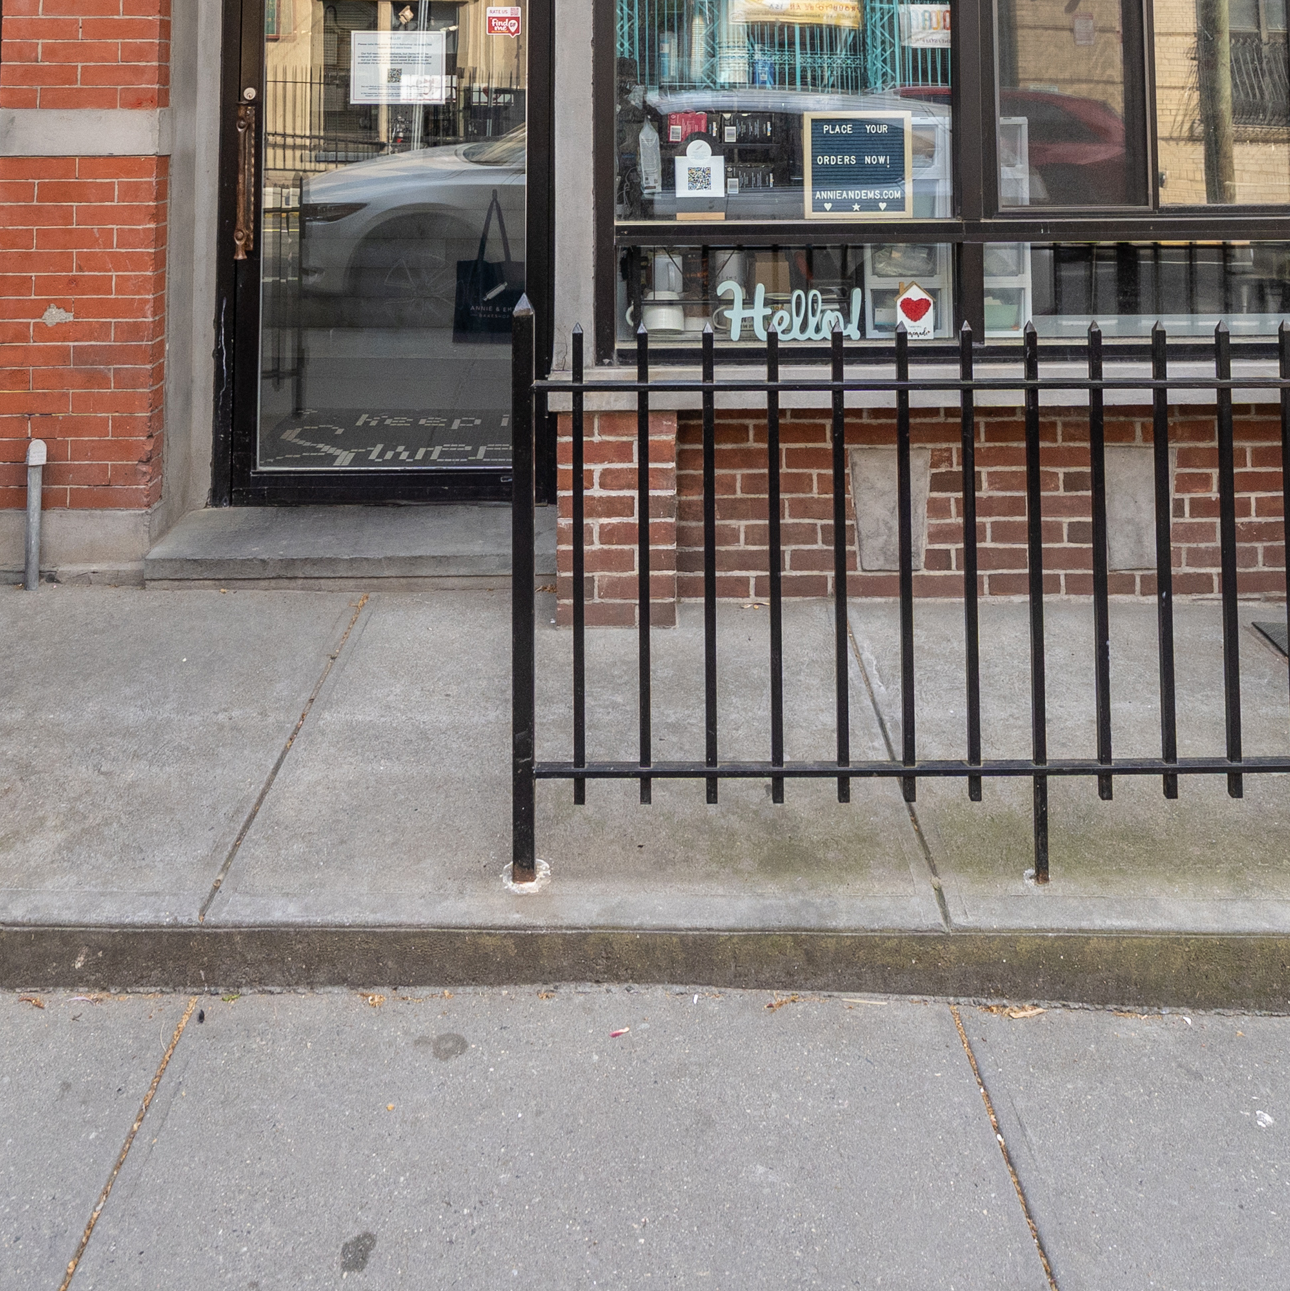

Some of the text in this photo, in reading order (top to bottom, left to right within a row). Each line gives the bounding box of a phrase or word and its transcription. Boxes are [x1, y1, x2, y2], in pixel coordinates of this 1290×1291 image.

[492, 18, 509, 27] Find
[823, 124, 889, 134] PLACE YOUR
[816, 155, 890, 168] ORDERS NOW!
[815, 190, 901, 200] ANNIEANDEMS.COM
[716, 280, 862, 342] Hello!
